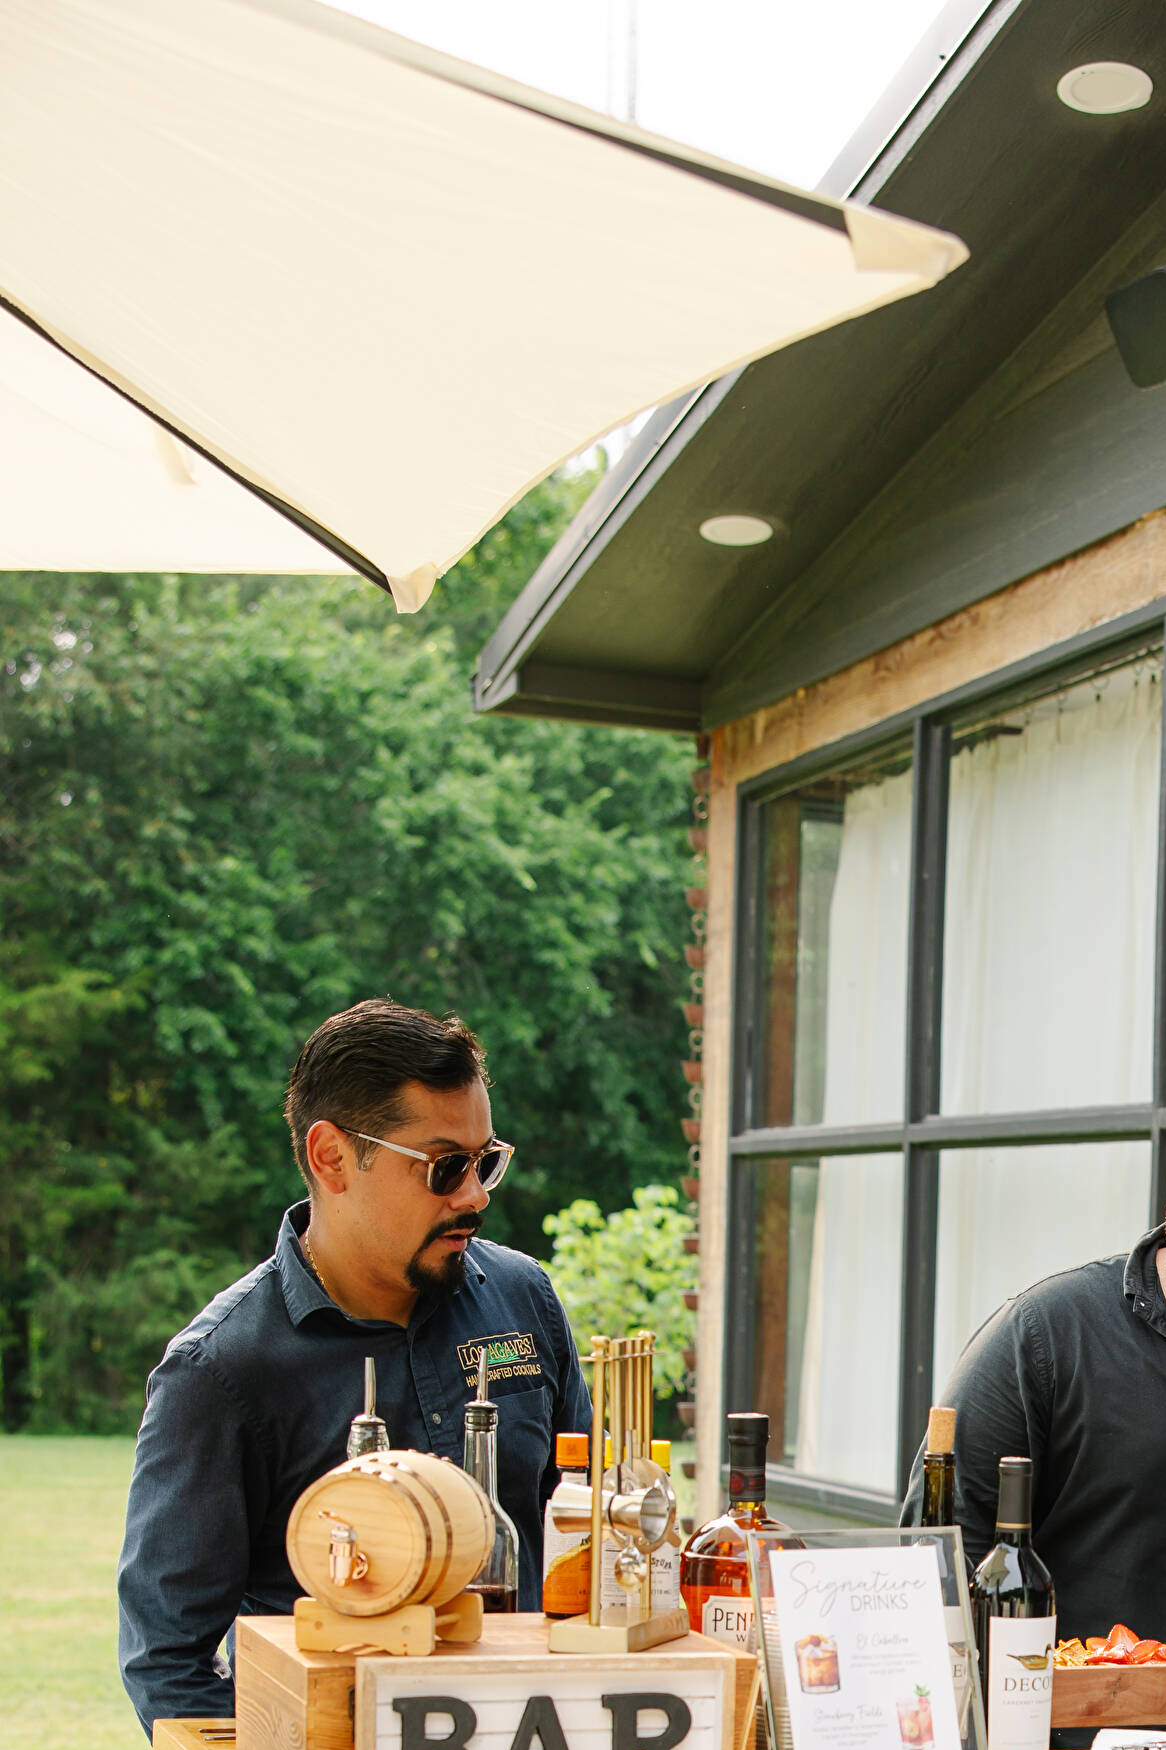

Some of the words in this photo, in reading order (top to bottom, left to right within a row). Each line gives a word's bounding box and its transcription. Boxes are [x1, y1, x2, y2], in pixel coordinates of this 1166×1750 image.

[488, 1337, 532, 1361] AGAVES
[465, 1366, 513, 1388] HANCRAFTED
[512, 1363, 542, 1377] COCKTAILS
[790, 1560, 927, 1618] Signature
[850, 1593, 910, 1612] DRINKS
[1003, 1676, 1052, 1692] DECO
